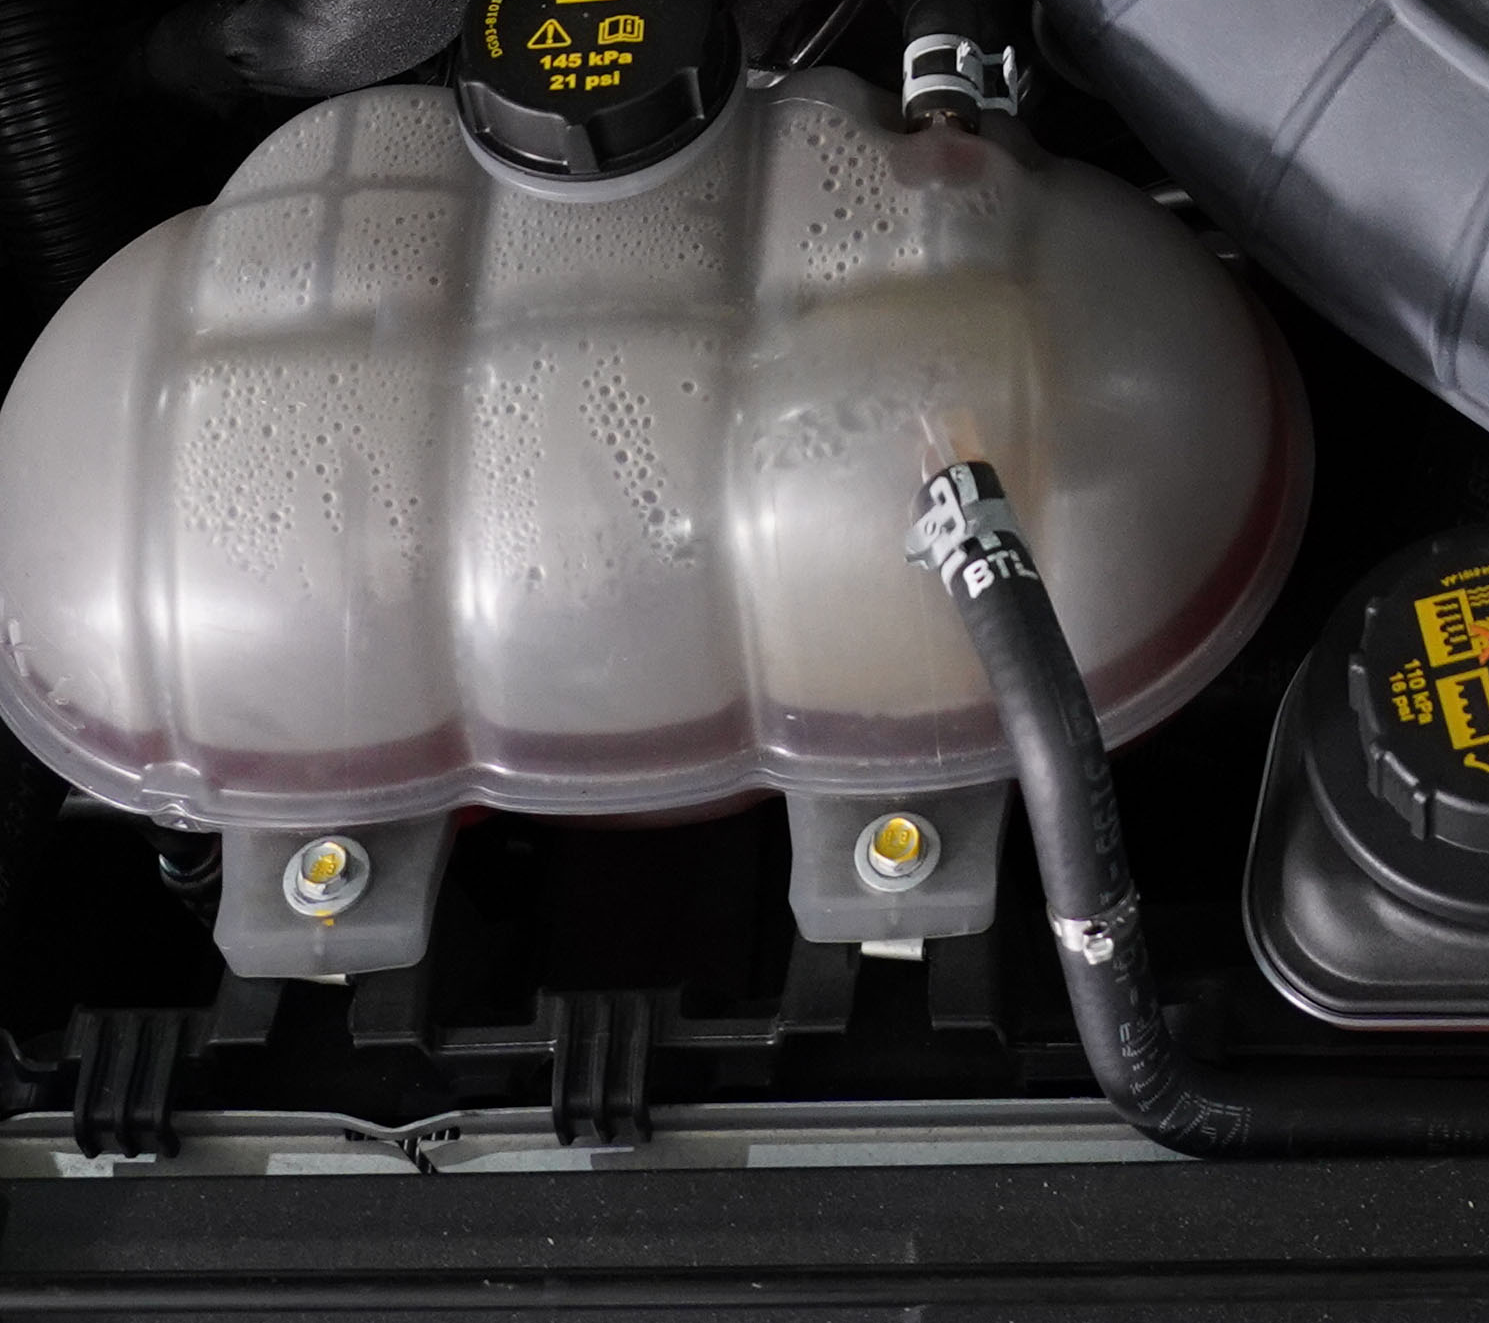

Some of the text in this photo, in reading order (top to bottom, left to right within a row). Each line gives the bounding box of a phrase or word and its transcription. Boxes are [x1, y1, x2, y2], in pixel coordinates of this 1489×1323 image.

[539, 49, 633, 71] 145 kPa
[549, 70, 621, 91] 21 psi
[1389, 672, 1408, 693] 16
[1404, 658, 1433, 725] 110 kPa
